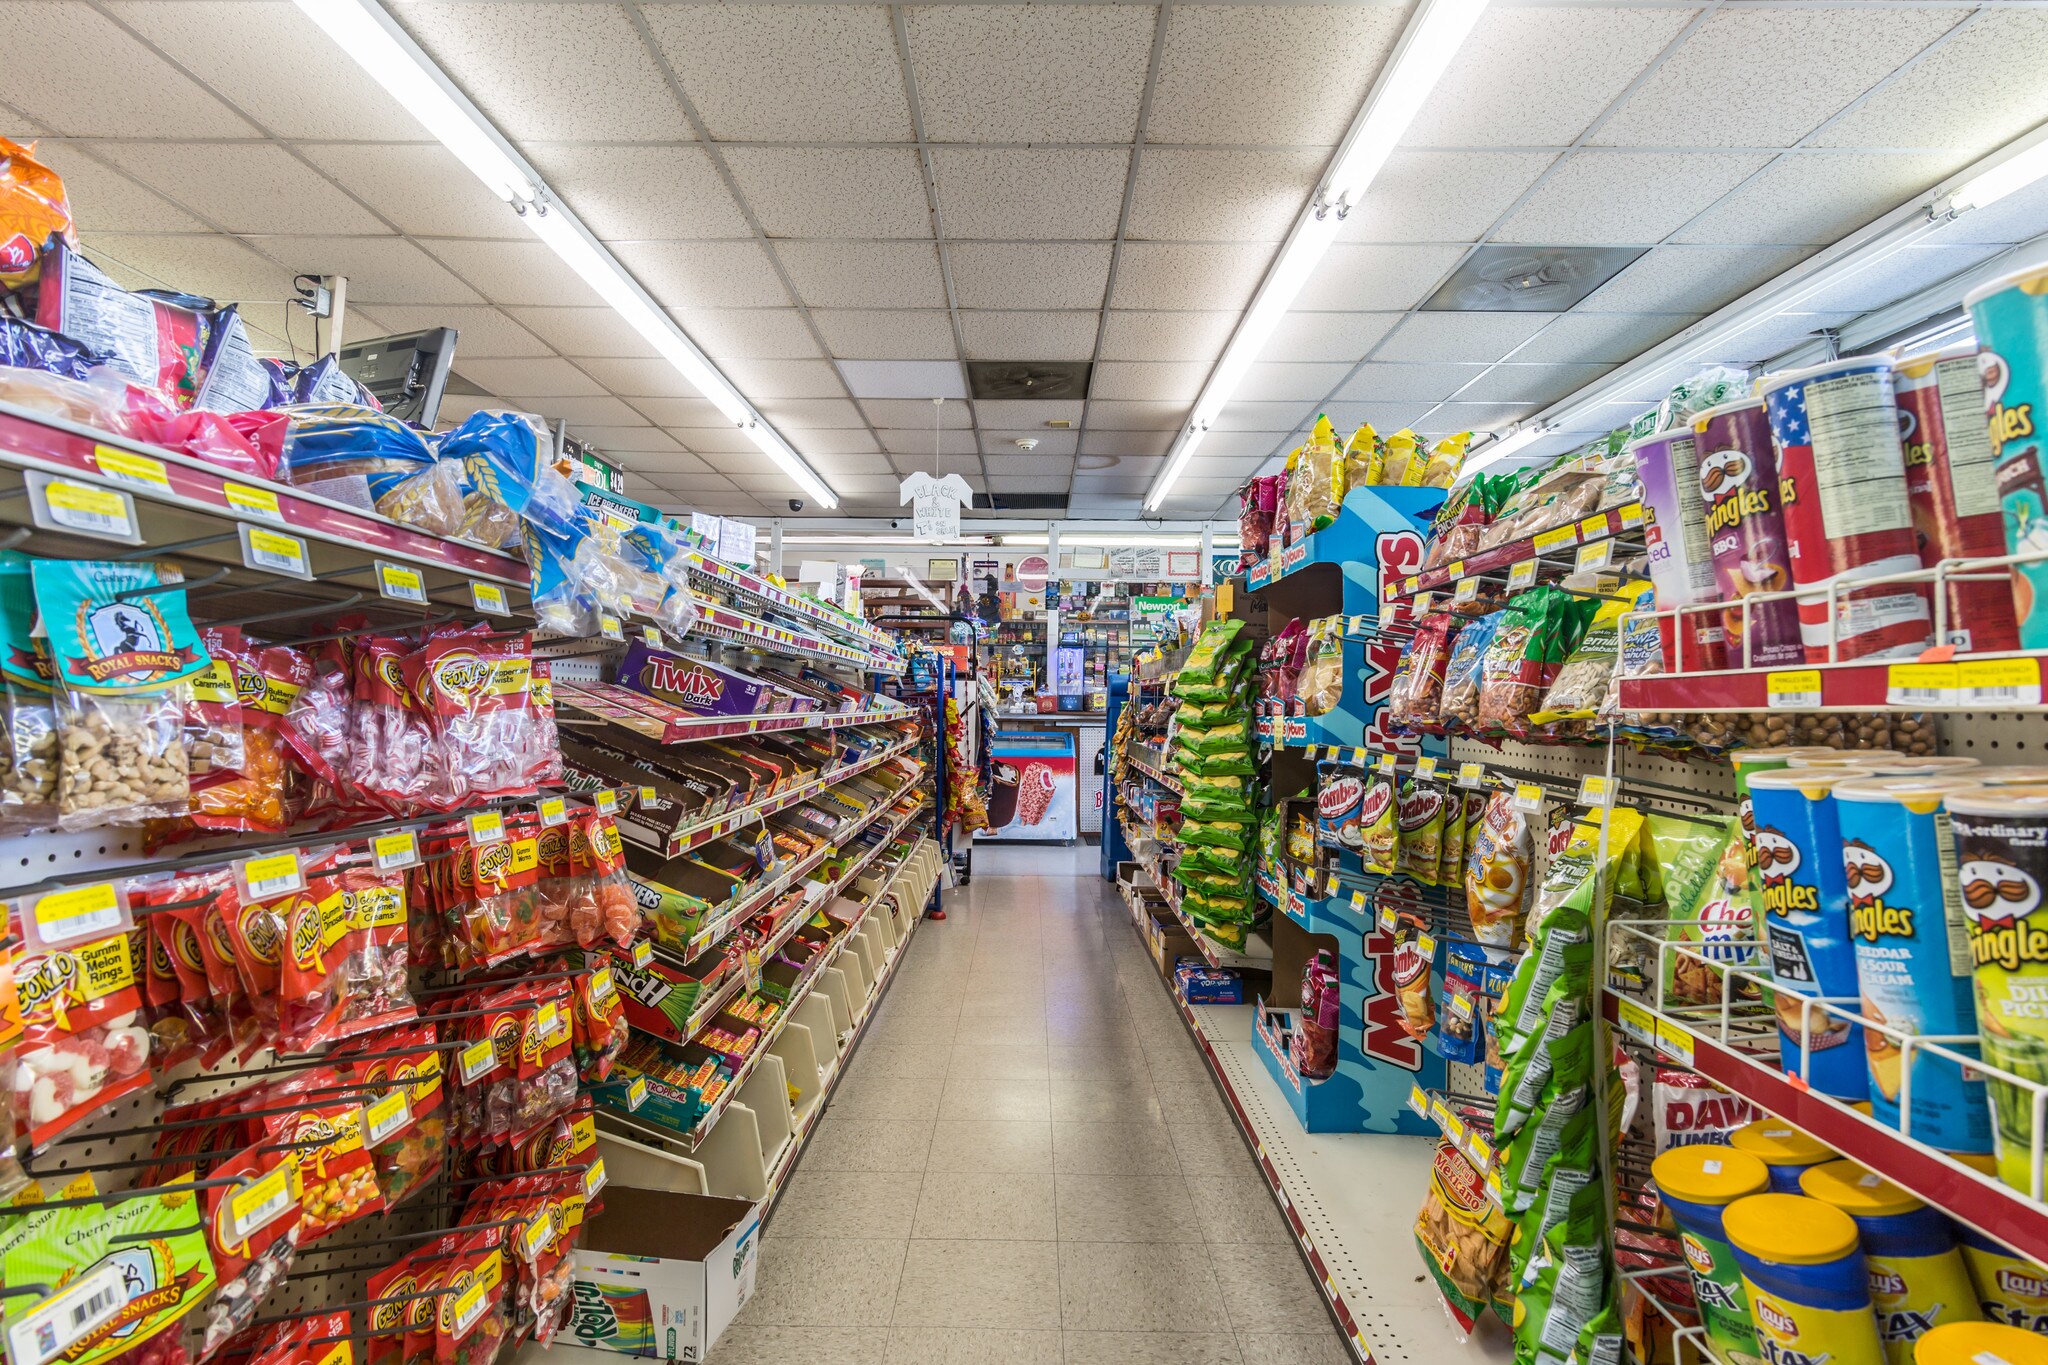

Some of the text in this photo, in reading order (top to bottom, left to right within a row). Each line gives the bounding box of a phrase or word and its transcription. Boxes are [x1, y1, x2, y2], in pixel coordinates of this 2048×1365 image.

[1989, 402, 2033, 457] gles
[914, 484, 957, 500] BLACK
[587, 493, 640, 520] ICE BREAKERS
[915, 507, 952, 518] WHITE
[931, 497, 940, 508] &
[1714, 536, 1739, 556] BBQ
[93, 571, 138, 584] Cashews
[1138, 600, 1182, 612] Newport
[1581, 644, 1620, 654] Calabaz
[86, 655, 181, 682] ROYAL SNACKS
[440, 661, 488, 688] GONZO
[193, 677, 232, 689] Caramels
[745, 684, 757, 693] 36
[269, 694, 290, 706] Discs
[685, 693, 713, 706] Dark
[683, 779, 698, 788] 36
[1362, 788, 1391, 817] ombos
[1400, 794, 1438, 823] ombos
[516, 847, 531, 857] Gummi
[538, 835, 569, 859] GONZO
[479, 844, 511, 879] GONZO
[518, 853, 532, 864] Worms
[1550, 860, 1589, 879] Semilla
[361, 901, 397, 914] Caramel
[1762, 878, 1819, 917] ingles
[321, 905, 343, 922] Gummi
[323, 914, 346, 932] Dinosau
[1699, 901, 1752, 933] Che
[1854, 898, 1914, 942] ngles
[293, 907, 321, 961] GONZO
[1551, 929, 1575, 941] Nutrition
[81, 940, 122, 962] Gummi
[1772, 939, 1793, 951] SALT
[1857, 945, 1913, 960] HEDDAR
[1972, 922, 2048, 970] ringle
[86, 954, 122, 974] Melon
[610, 957, 648, 980] SOUR
[1394, 945, 1419, 973] ombos
[1868, 960, 1908, 973] SOUR
[16, 953, 75, 1015] GONZO
[89, 966, 124, 985] Rings
[1867, 974, 1915, 986] REAM
[2009, 985, 2048, 1002] DIL
[665, 1027, 676, 1035] 24
[646, 1080, 687, 1104] TROPICAL
[67, 1182, 91, 1195] Royal
[1434, 1151, 1481, 1212] Mexicano
[16, 1190, 40, 1202] Royal
[28, 1209, 57, 1231] Sours
[64, 1204, 150, 1247] Cherry Sours
[1683, 1241, 1712, 1267] Lay's
[1692, 1271, 1740, 1312] tAX
[1869, 1273, 1904, 1296] ay's
[64, 1285, 181, 1362] ROYAL SNACKS
[569, 1305, 580, 1328] FRUIT
[1757, 1304, 1797, 1340] Lay's
[1878, 1303, 1946, 1342] tAX
[667, 1330, 676, 1352] FLAVORS!
[683, 1345, 694, 1359] 72
